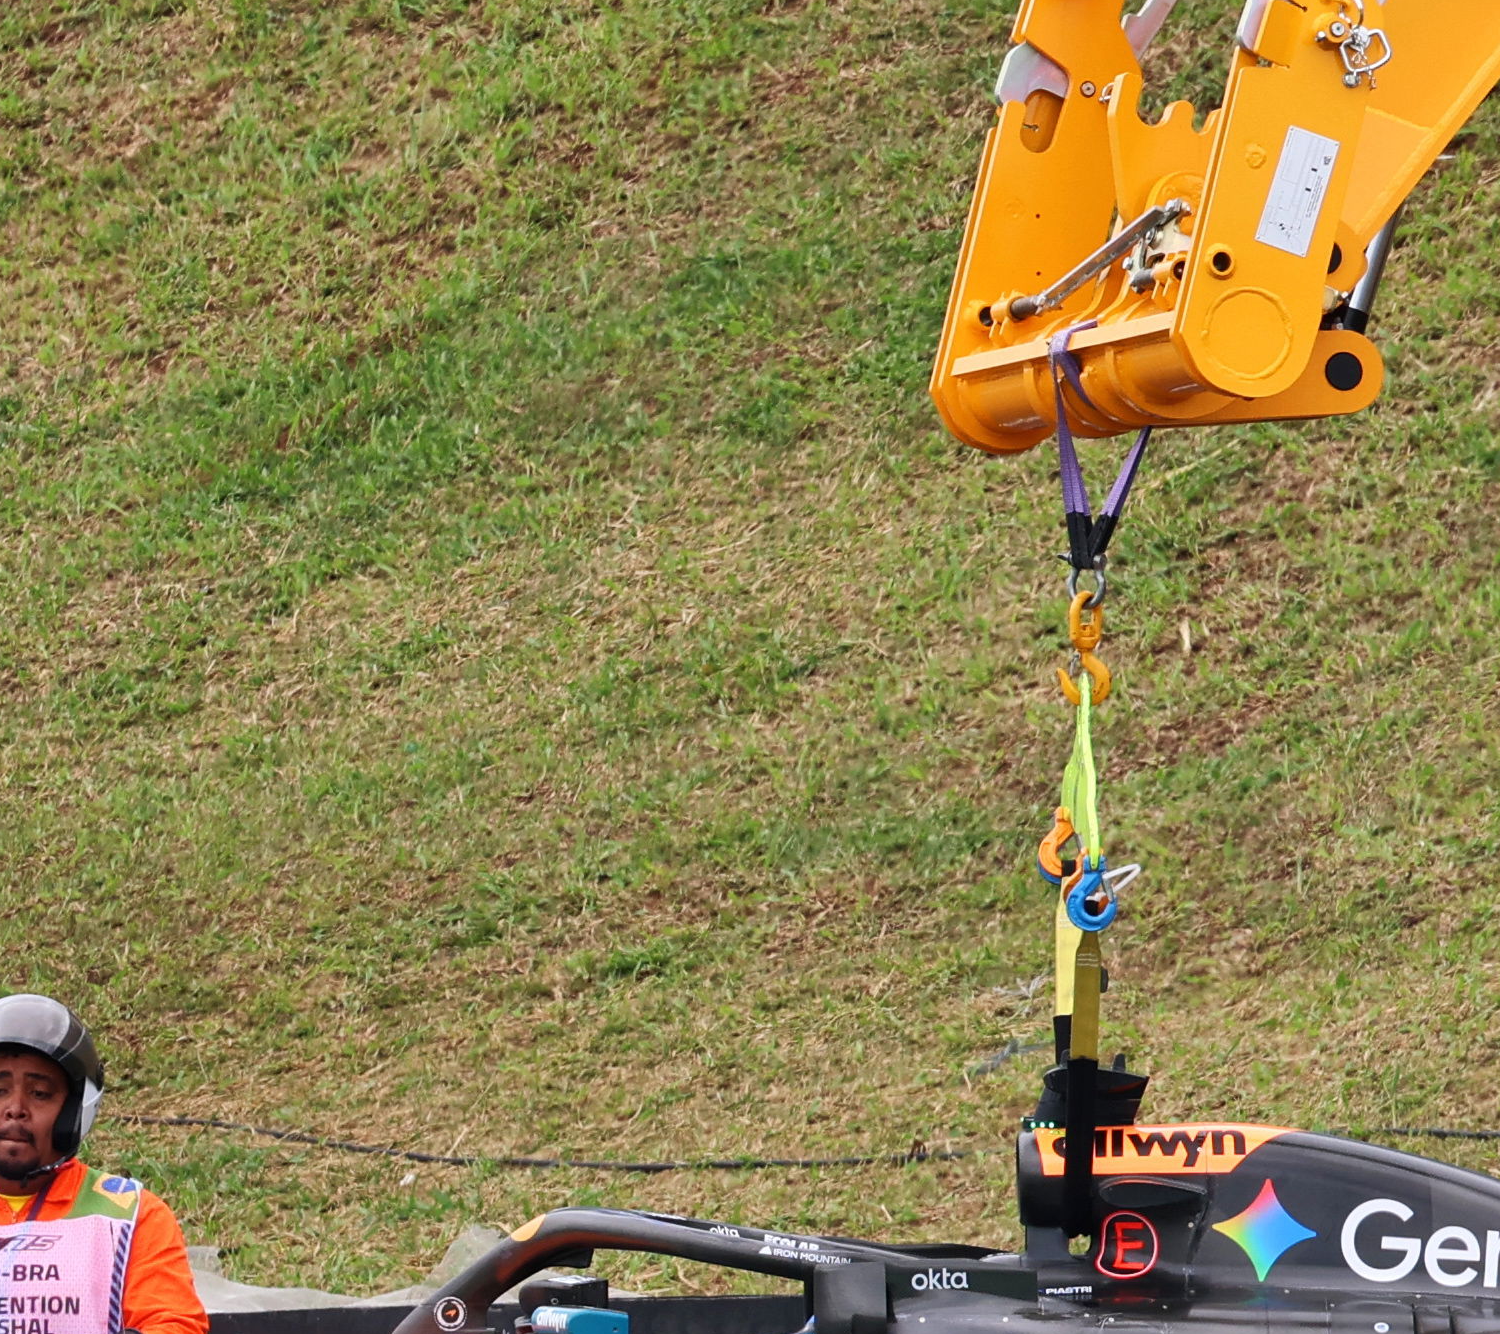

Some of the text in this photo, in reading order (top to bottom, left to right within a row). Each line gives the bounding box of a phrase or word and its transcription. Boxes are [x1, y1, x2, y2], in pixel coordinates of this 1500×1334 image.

[773, 1247, 799, 1260] IRON
[1113, 1221, 1145, 1269] E
[911, 1268, 969, 1291] okta
[1045, 1285, 1093, 1295] PIASTRI
